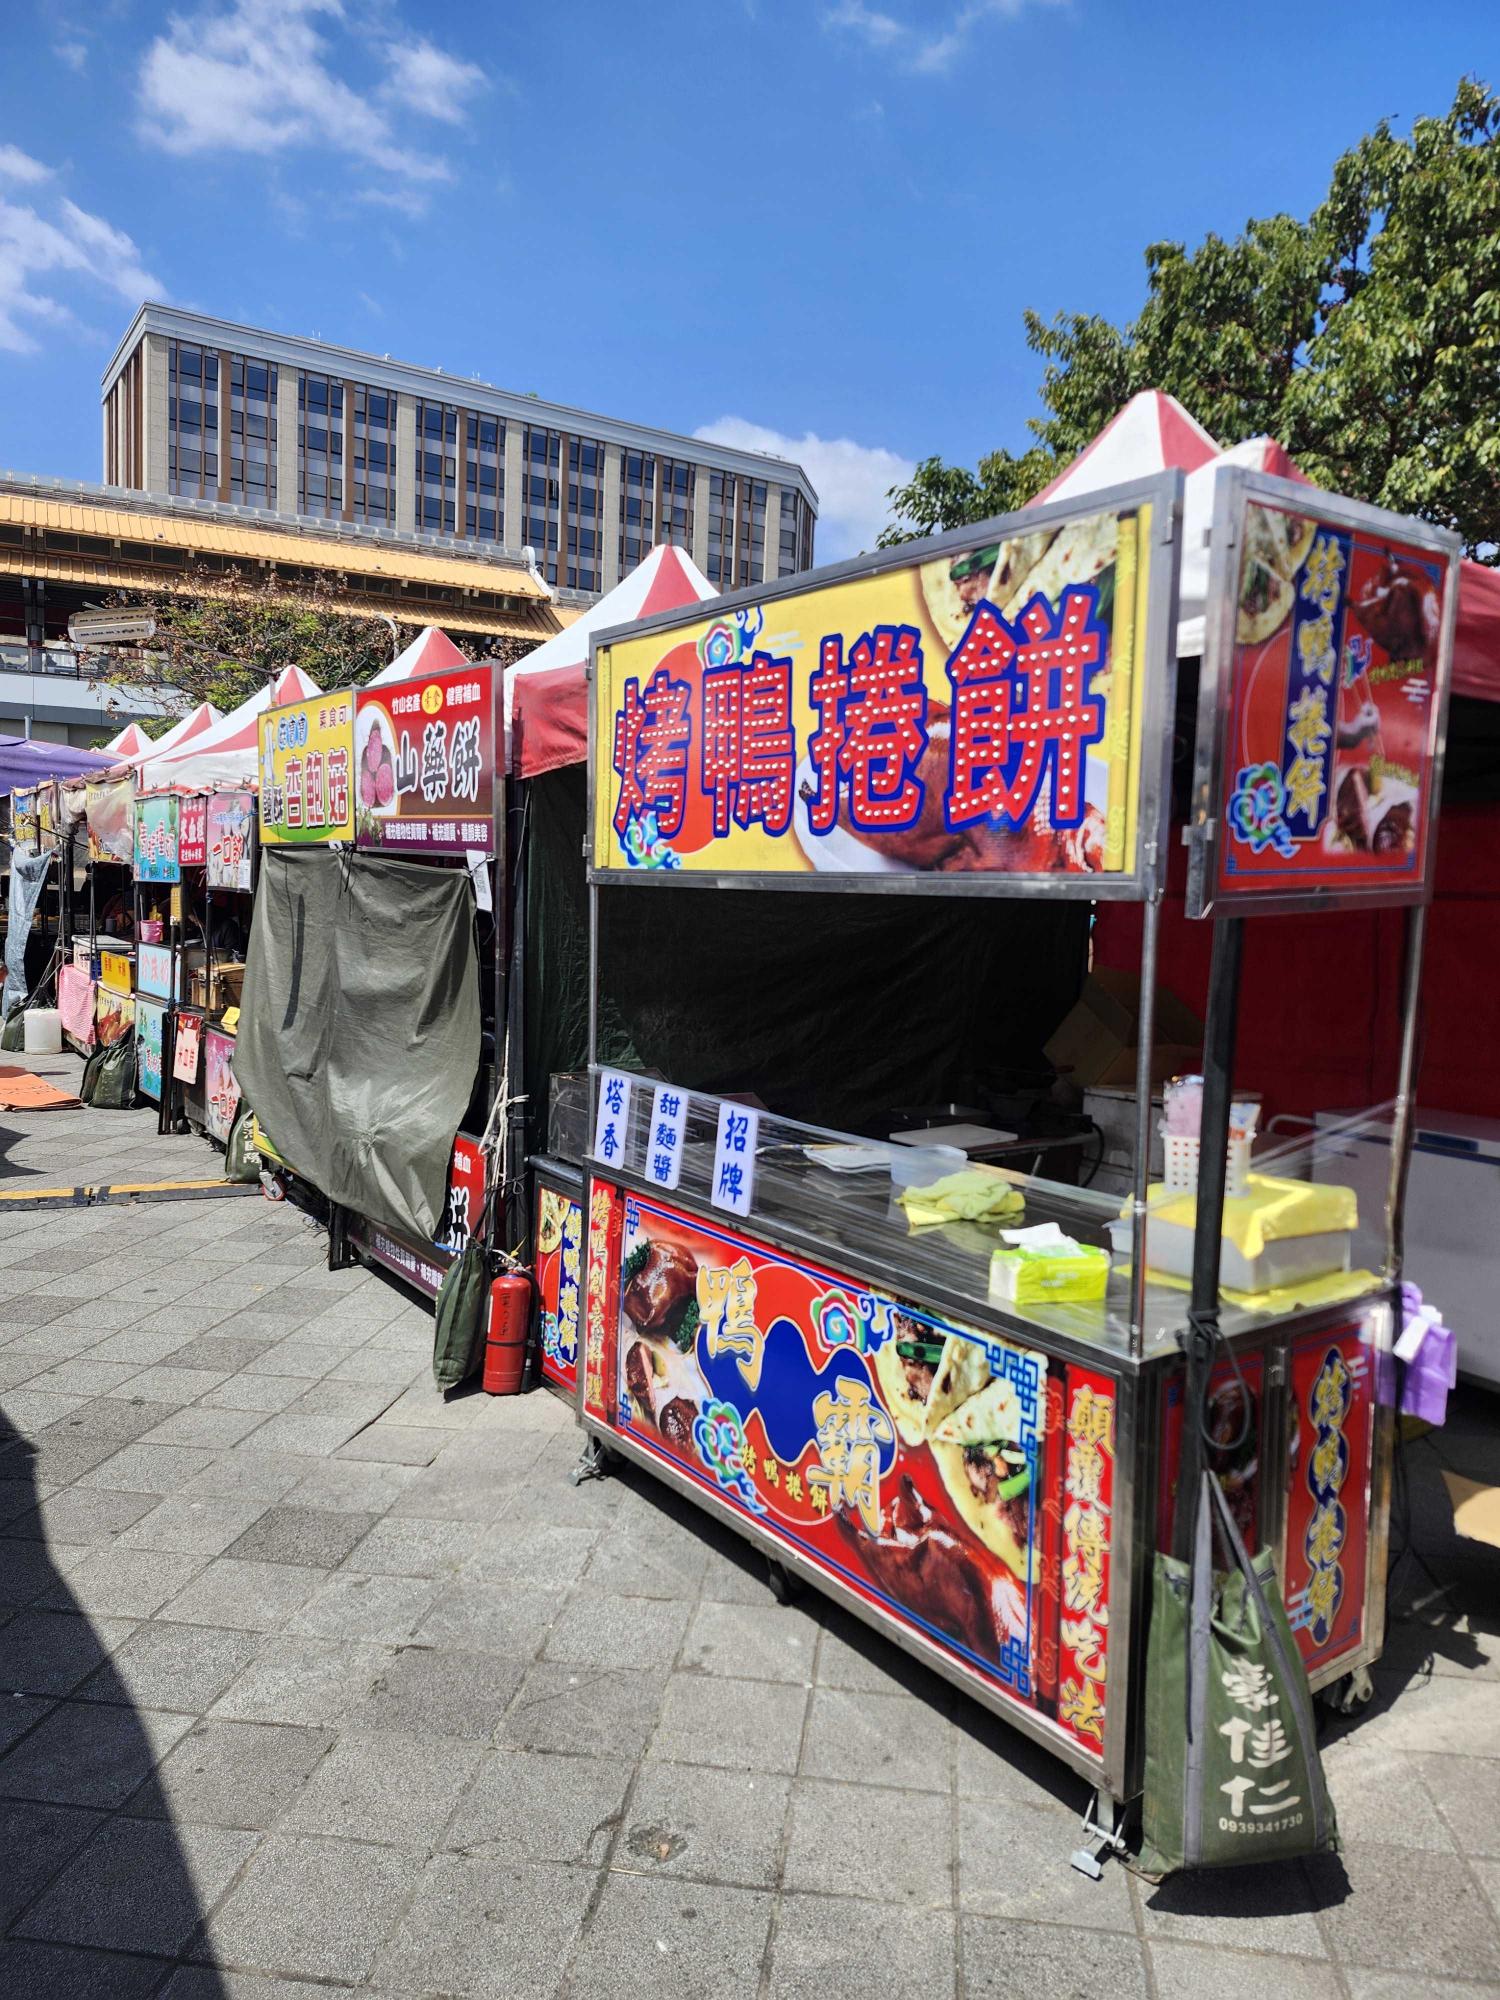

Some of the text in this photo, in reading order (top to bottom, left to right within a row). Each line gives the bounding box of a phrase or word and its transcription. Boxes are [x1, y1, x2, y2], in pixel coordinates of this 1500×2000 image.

[392, 692, 421, 715] 竹山名產
[446, 682, 481, 706] 健胃補血
[613, 584, 1105, 838] 烤鴨捲餅
[285, 746, 349, 829] 杏鮑菇
[395, 715, 483, 803] 山藥餅
[600, 1078, 625, 1160] 塔香
[653, 1092, 681, 1182] 甜麵醬
[718, 1109, 749, 1205] 招牌
[587, 1188, 613, 1409] 烤鴨創意料理
[740, 1443, 829, 1518] 烤鴨捲餅
[1219, 1812, 1304, 1836] 0939341730
